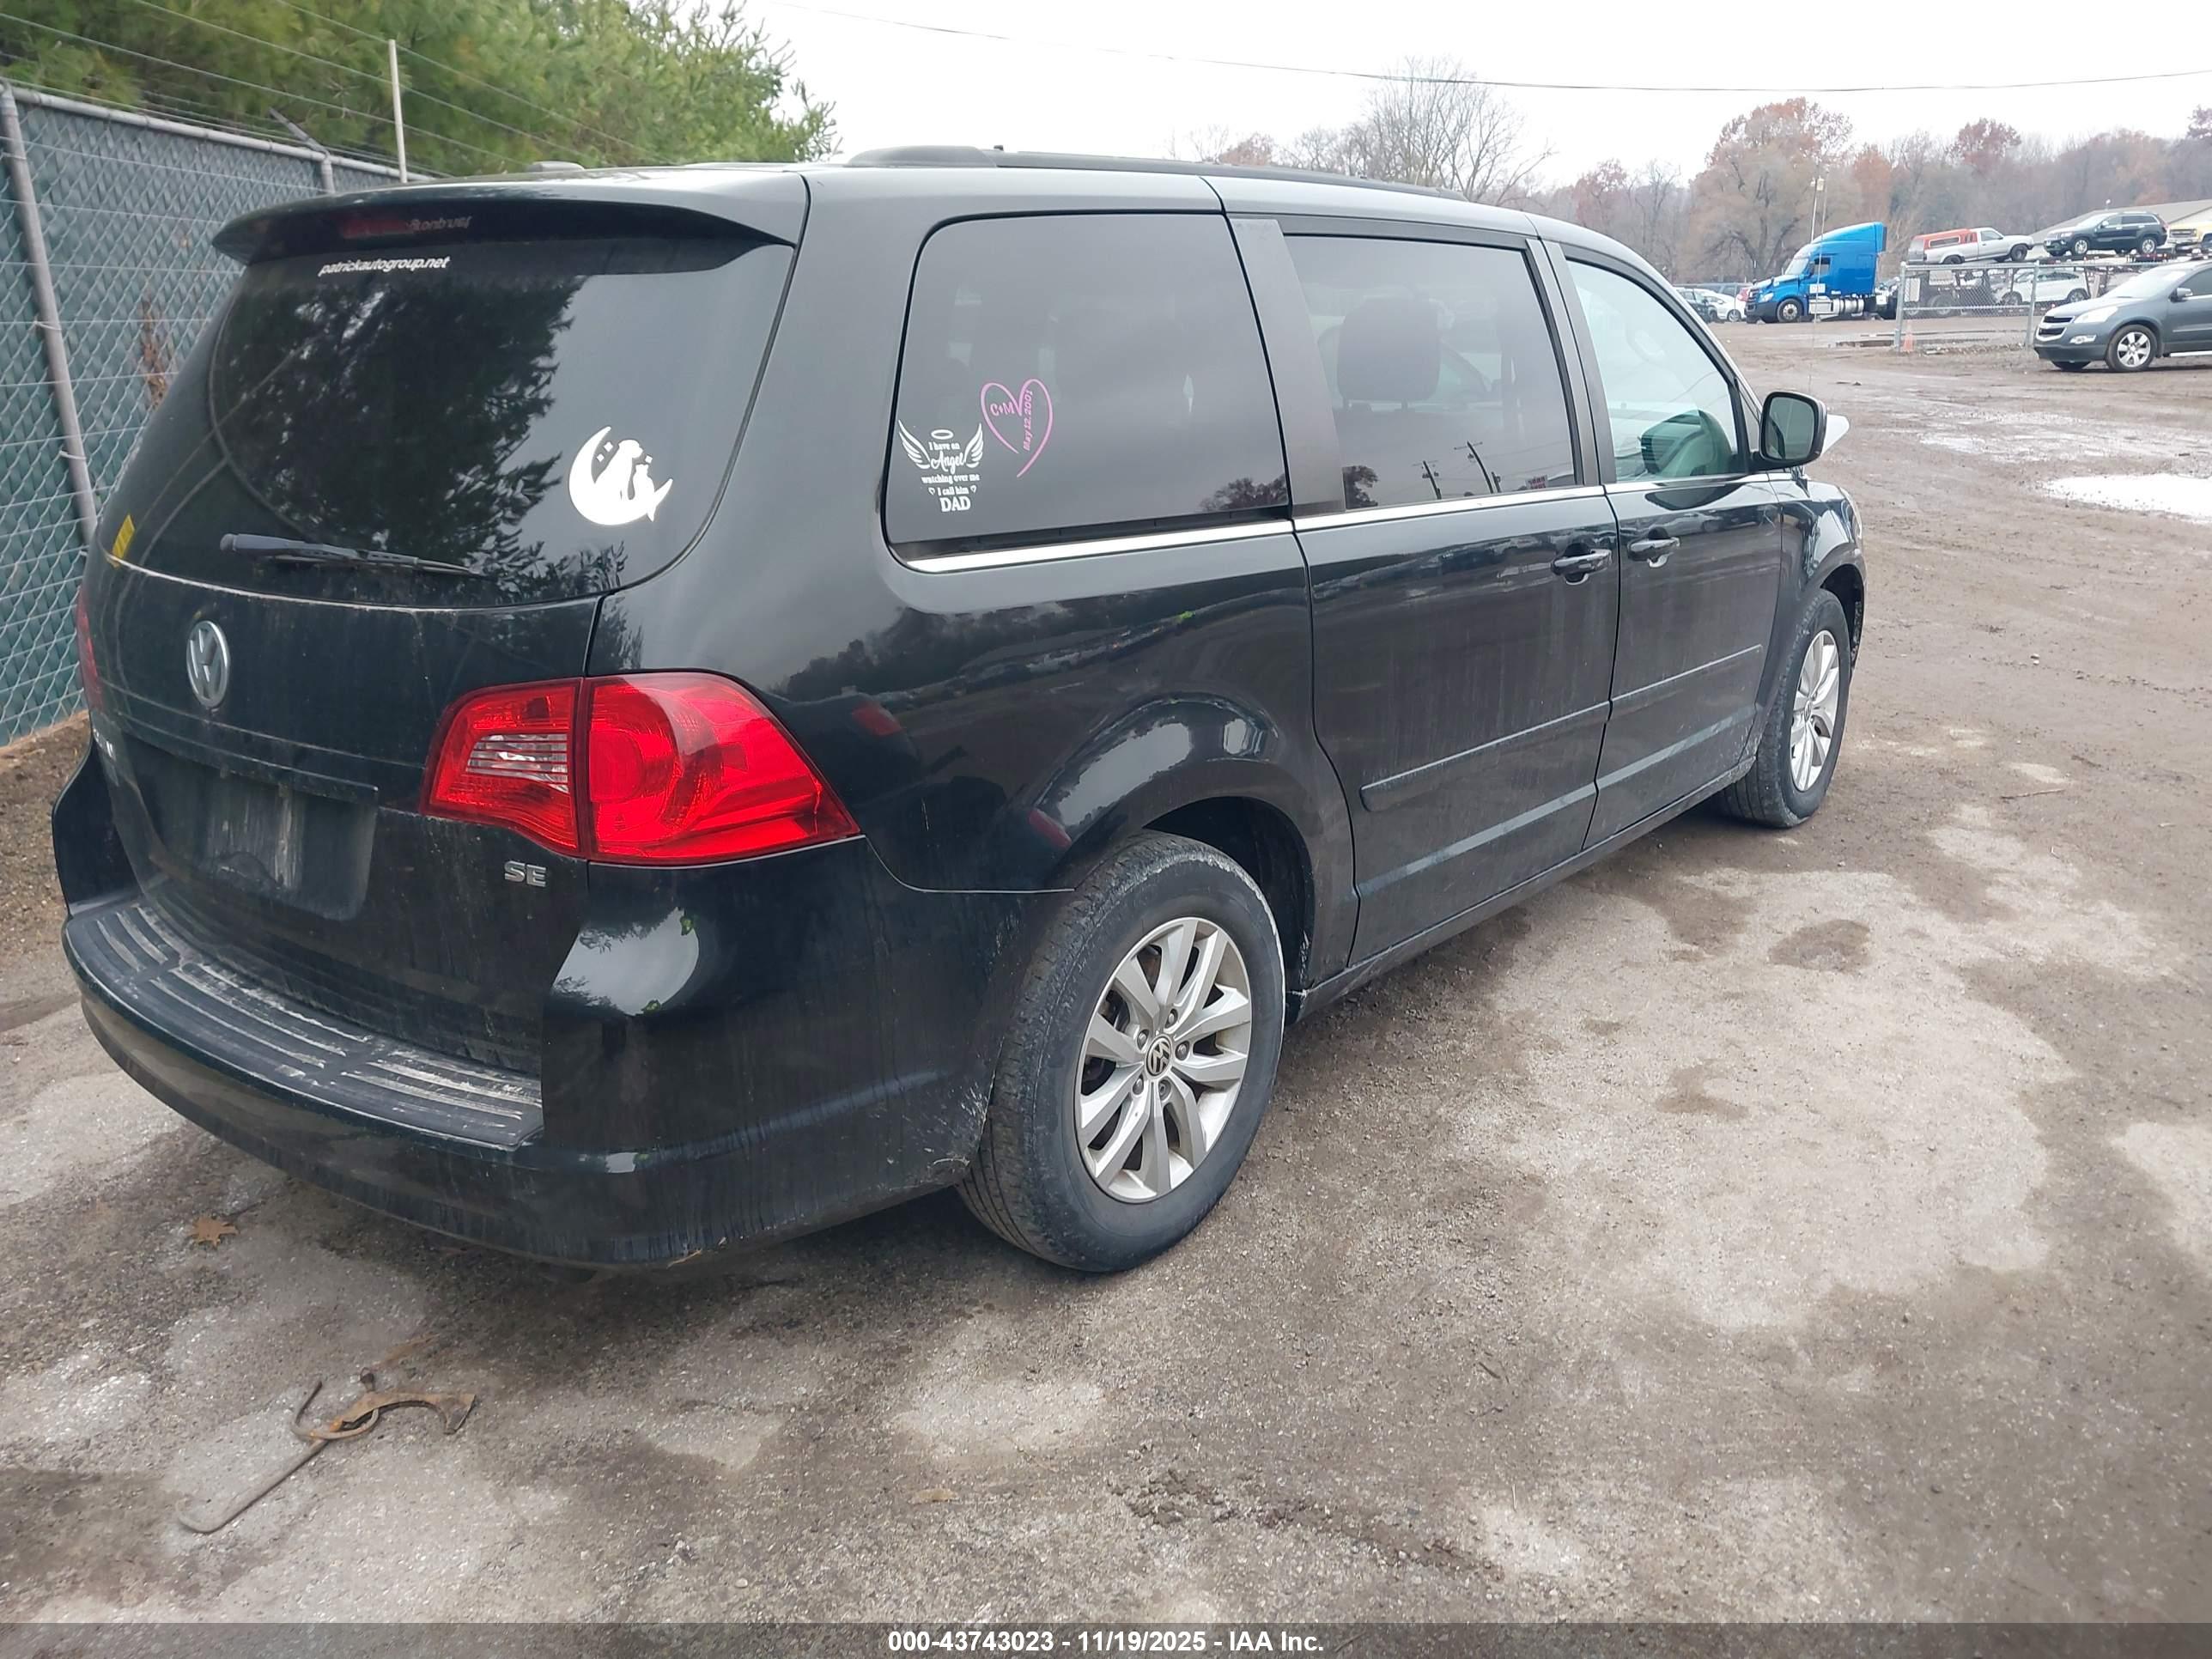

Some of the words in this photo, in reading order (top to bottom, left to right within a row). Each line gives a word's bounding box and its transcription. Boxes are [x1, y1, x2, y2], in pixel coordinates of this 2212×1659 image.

[318, 256, 451, 277] patrickautogroup.net
[928, 441, 933, 451] I
[933, 441, 951, 450] have
[1023, 430, 1033, 451] May
[930, 450, 964, 475] Angel
[921, 474, 953, 484] watching
[953, 474, 969, 483] over
[969, 473, 981, 482] me
[937, 487, 942, 496] I
[942, 486, 956, 495] call
[955, 485, 969, 495] him
[939, 495, 971, 513] DAD
[504, 860, 546, 887] SE
